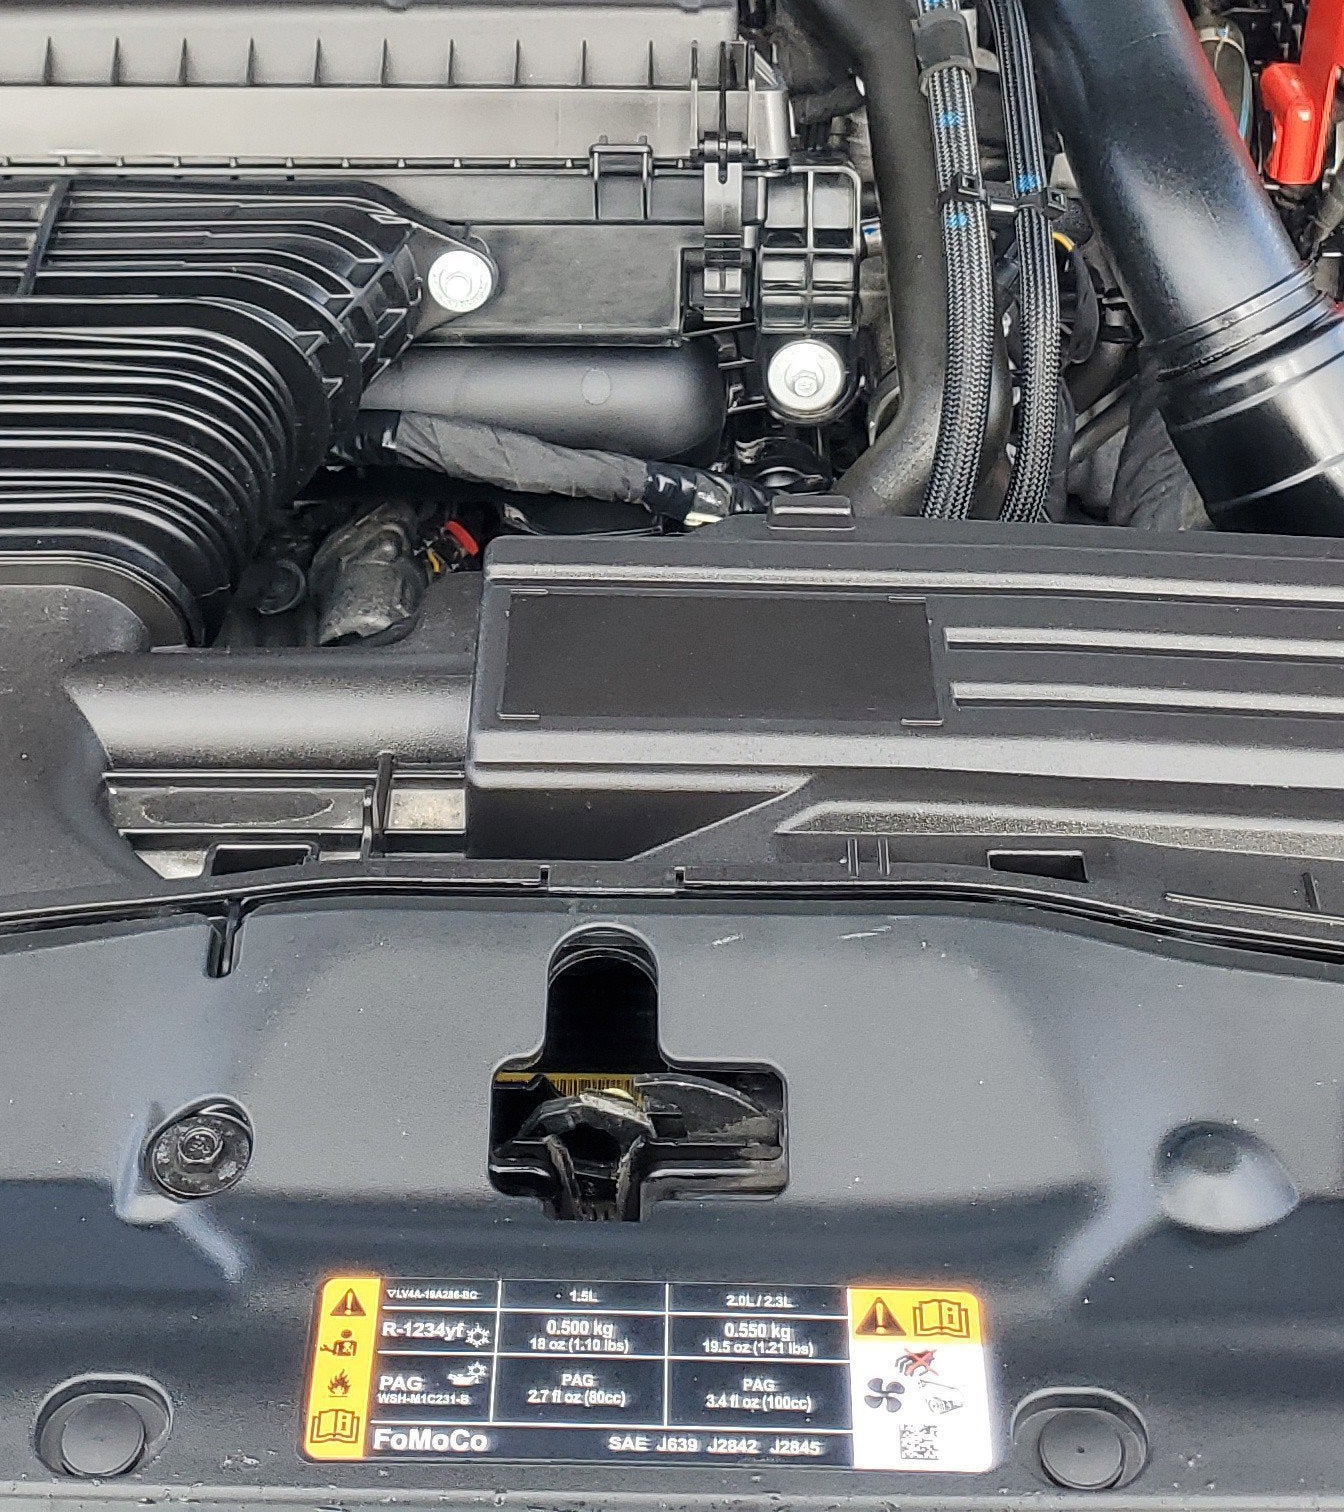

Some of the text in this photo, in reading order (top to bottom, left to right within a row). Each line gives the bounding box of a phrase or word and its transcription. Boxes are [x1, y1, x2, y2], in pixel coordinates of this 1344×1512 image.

[569, 1290, 598, 1302] 1.5L
[726, 1294, 755, 1307] 2.0L
[764, 1295, 793, 1308] 2.3L
[382, 1321, 465, 1341] R-1234yf
[546, 1319, 614, 1339] 0.500 kg
[724, 1322, 791, 1341] 0.550 kg
[530, 1337, 629, 1354] 18 oz (1.10 lbs)
[702, 1340, 814, 1358] 19.5 oz (1.21 lbs)
[379, 1375, 424, 1391] PAG
[561, 1373, 595, 1387] PAG
[742, 1377, 776, 1392] PAG
[378, 1392, 470, 1405] WSH-M1C231-B
[527, 1389, 626, 1407] 2.7 fl oz (80cc)
[706, 1393, 812, 1413] 3.4 fl oz (100cc)
[373, 1428, 488, 1452] FoMoCo
[608, 1436, 822, 1456] SAE J639 J2842 J2845
